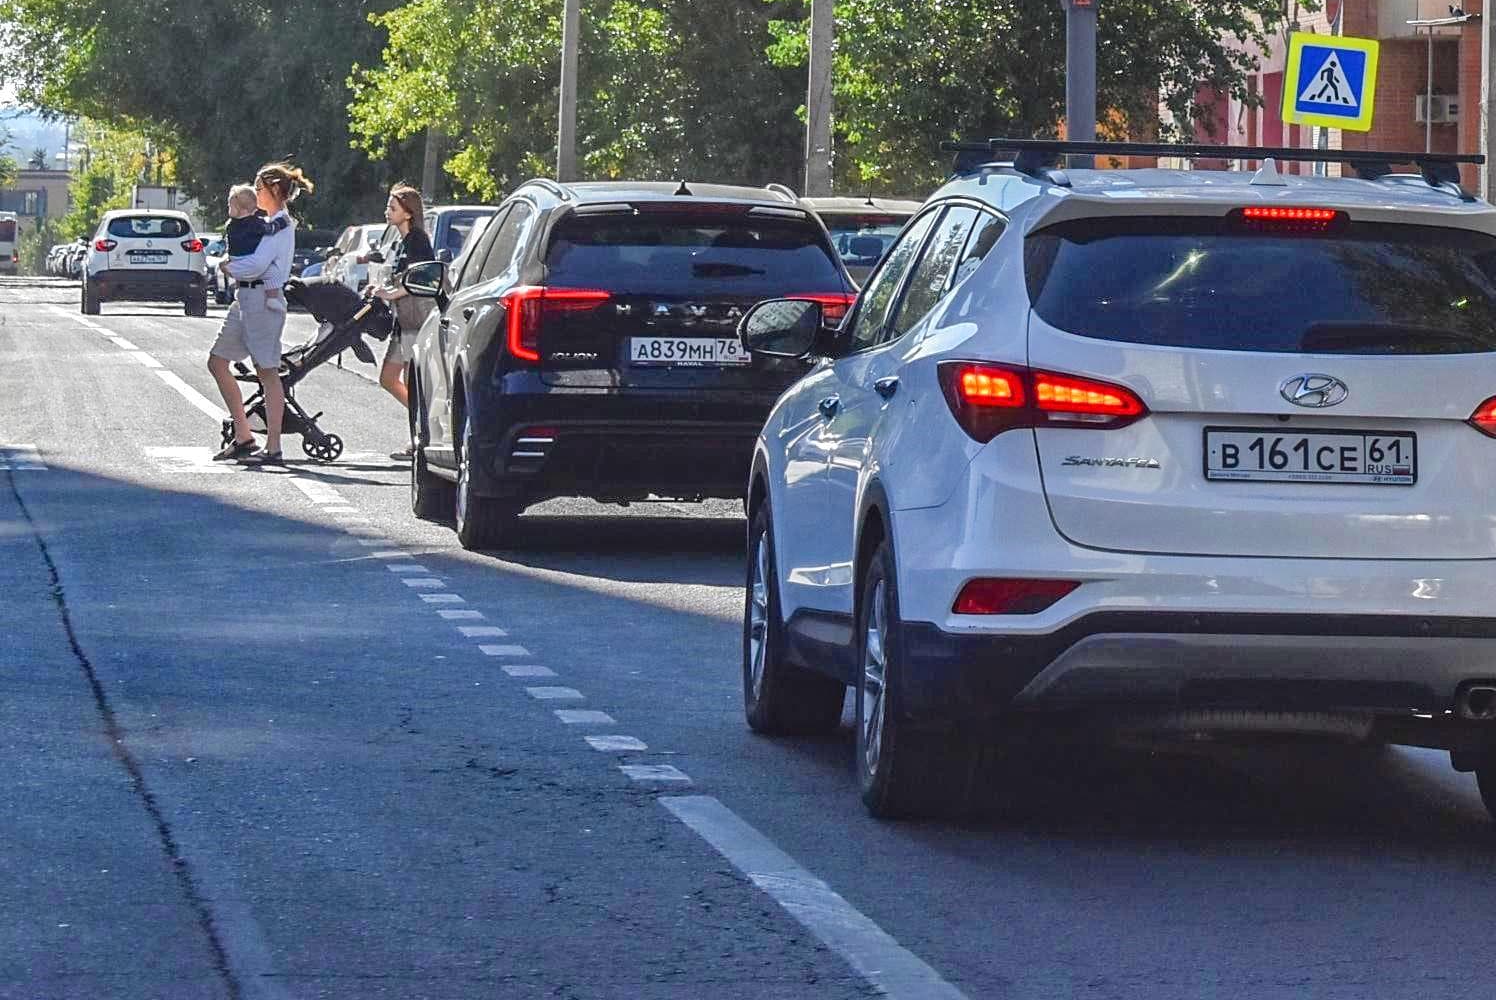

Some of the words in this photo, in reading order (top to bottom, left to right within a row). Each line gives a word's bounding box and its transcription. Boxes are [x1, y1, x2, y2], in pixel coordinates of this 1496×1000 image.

[616, 304, 742, 316] HAVA
[637, 340, 714, 360] А839МН
[1222, 437, 1358, 472] В161СЕ
[1369, 438, 1402, 464] 61
[1367, 464, 1392, 475] RUS
